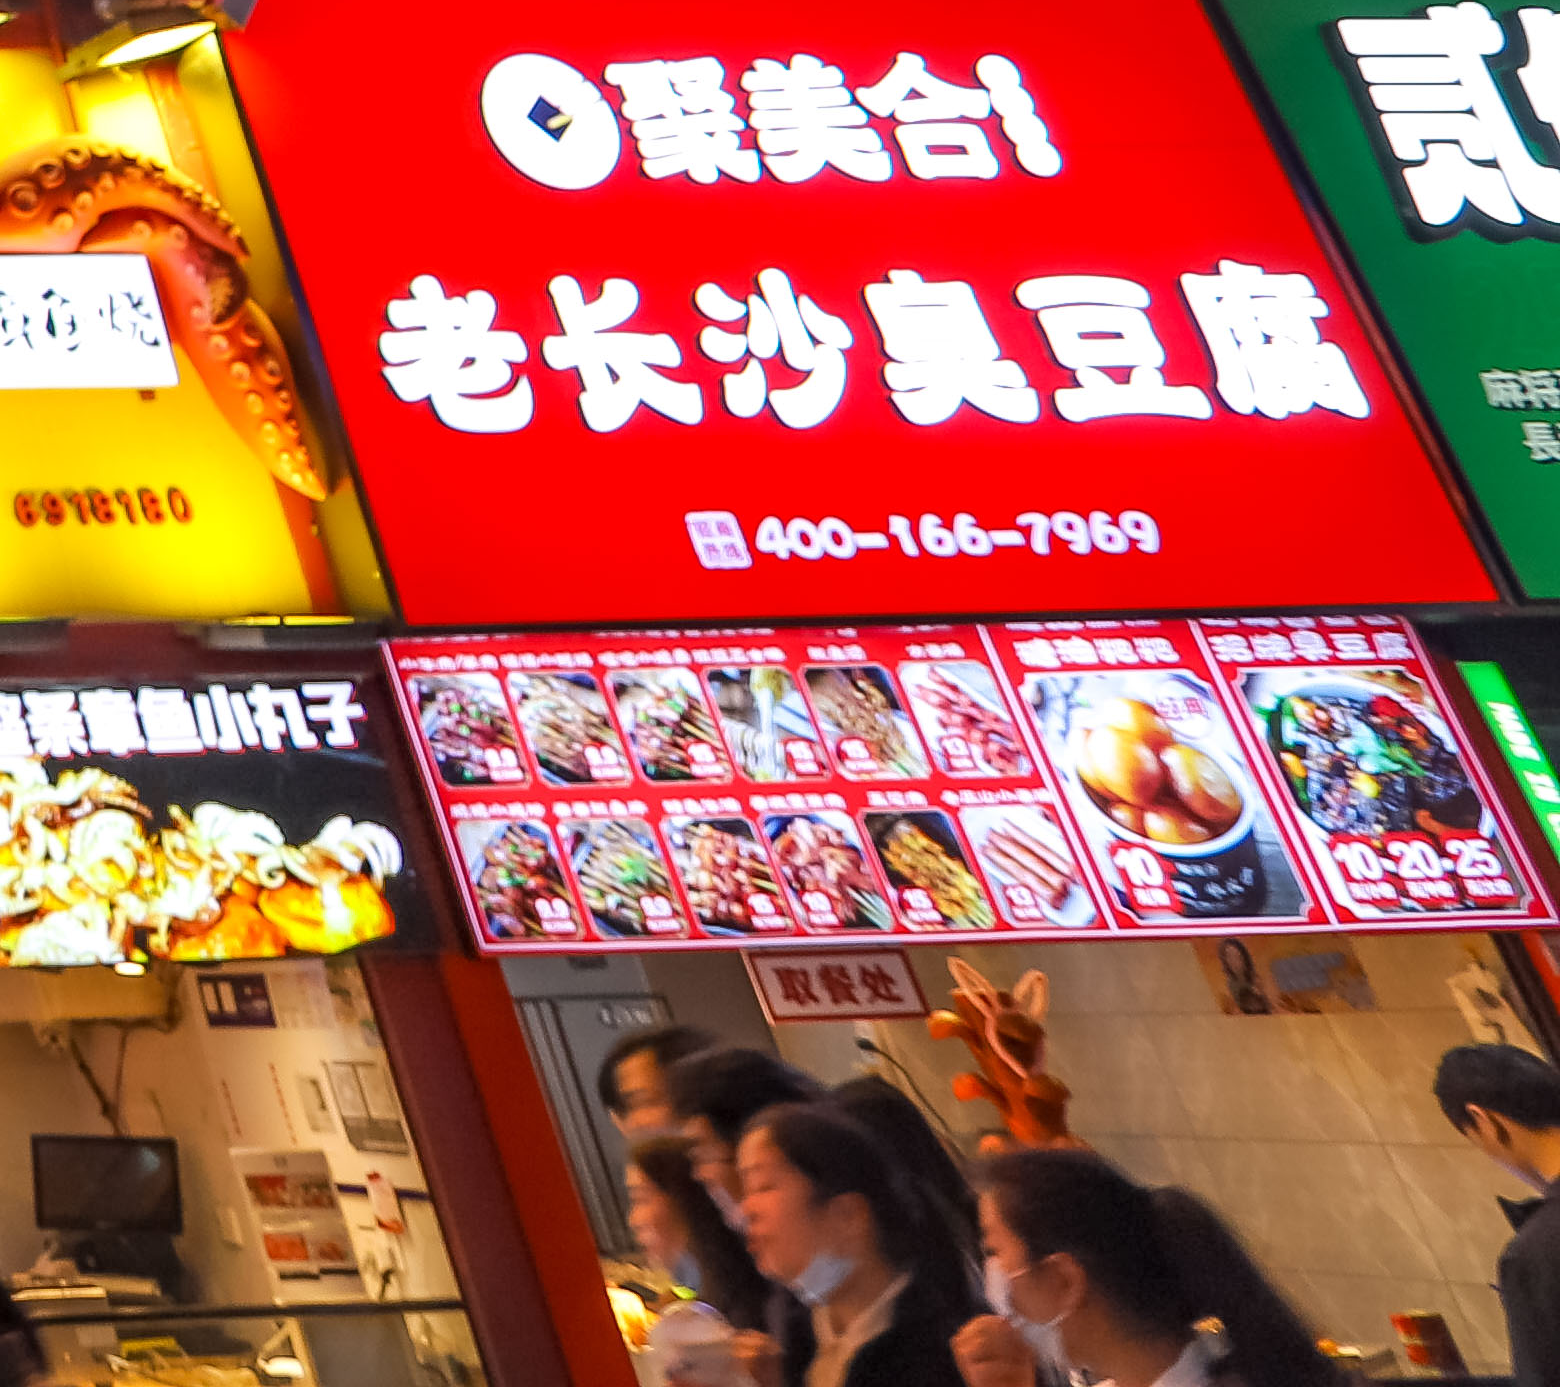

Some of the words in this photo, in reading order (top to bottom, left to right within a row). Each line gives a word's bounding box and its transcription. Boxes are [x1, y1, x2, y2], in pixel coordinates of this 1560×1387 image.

[379, 261, 1372, 432] 老长沙臭豆腐
[754, 510, 1161, 563] 400-166-7969
[1118, 847, 1163, 886] 10
[776, 958, 902, 1008] 取餐处
